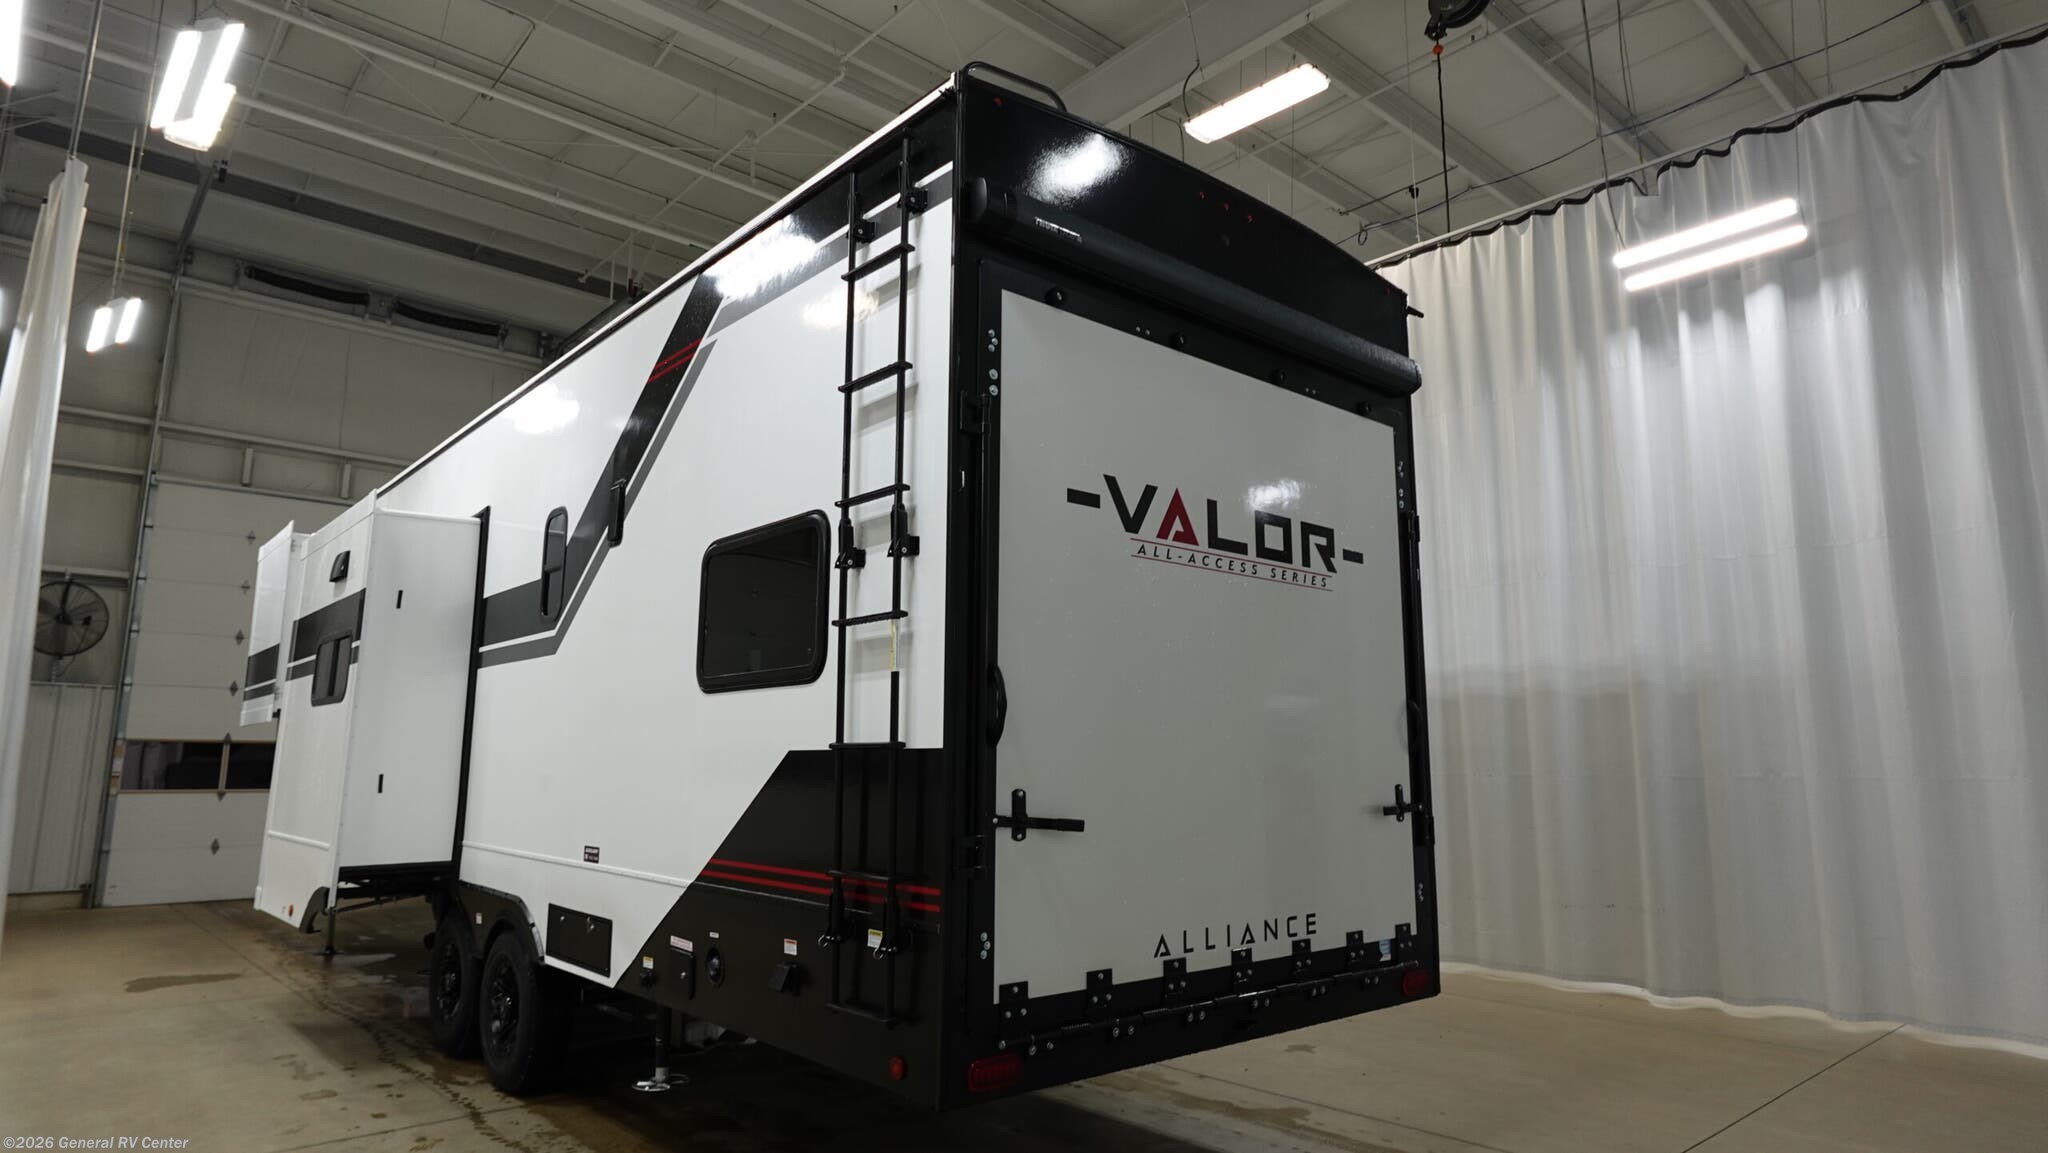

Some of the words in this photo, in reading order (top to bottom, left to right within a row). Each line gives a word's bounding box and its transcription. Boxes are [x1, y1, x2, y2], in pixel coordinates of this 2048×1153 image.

[1137, 543, 1258, 576] ALL-ACCESS
[1270, 567, 1328, 588] SERIES
[1154, 913, 1317, 958] ALLIANCE
